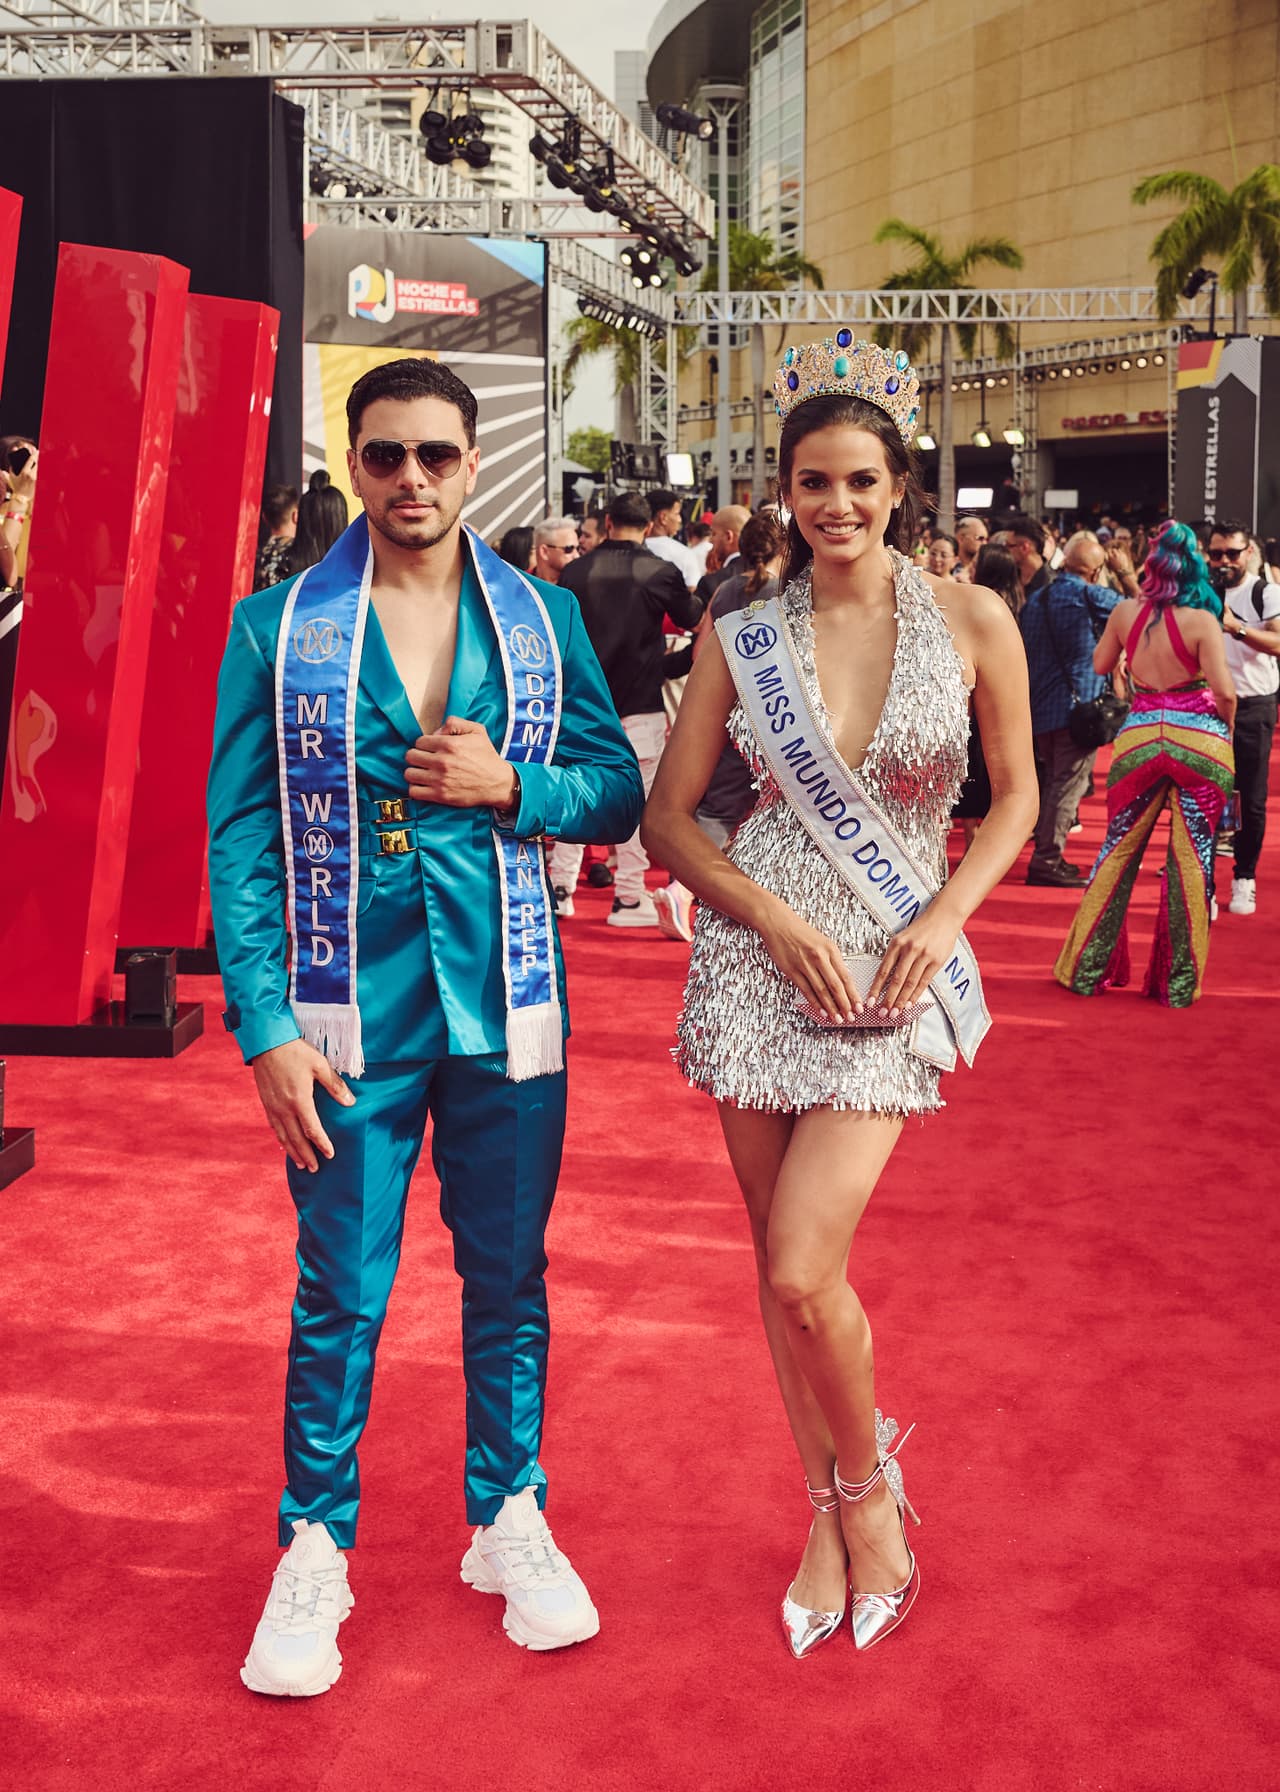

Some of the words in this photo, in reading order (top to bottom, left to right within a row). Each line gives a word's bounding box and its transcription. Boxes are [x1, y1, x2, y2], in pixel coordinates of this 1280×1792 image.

[397, 281, 449, 298] NOCHE
[450, 289, 465, 299] DE
[397, 297, 477, 313] ESTRELLAS
[1204, 396, 1220, 500] ESTRELLAS
[296, 693, 329, 761] MR
[753, 664, 796, 735] MISS
[780, 736, 864, 842] MUNDO
[520, 903, 539, 977] REP
